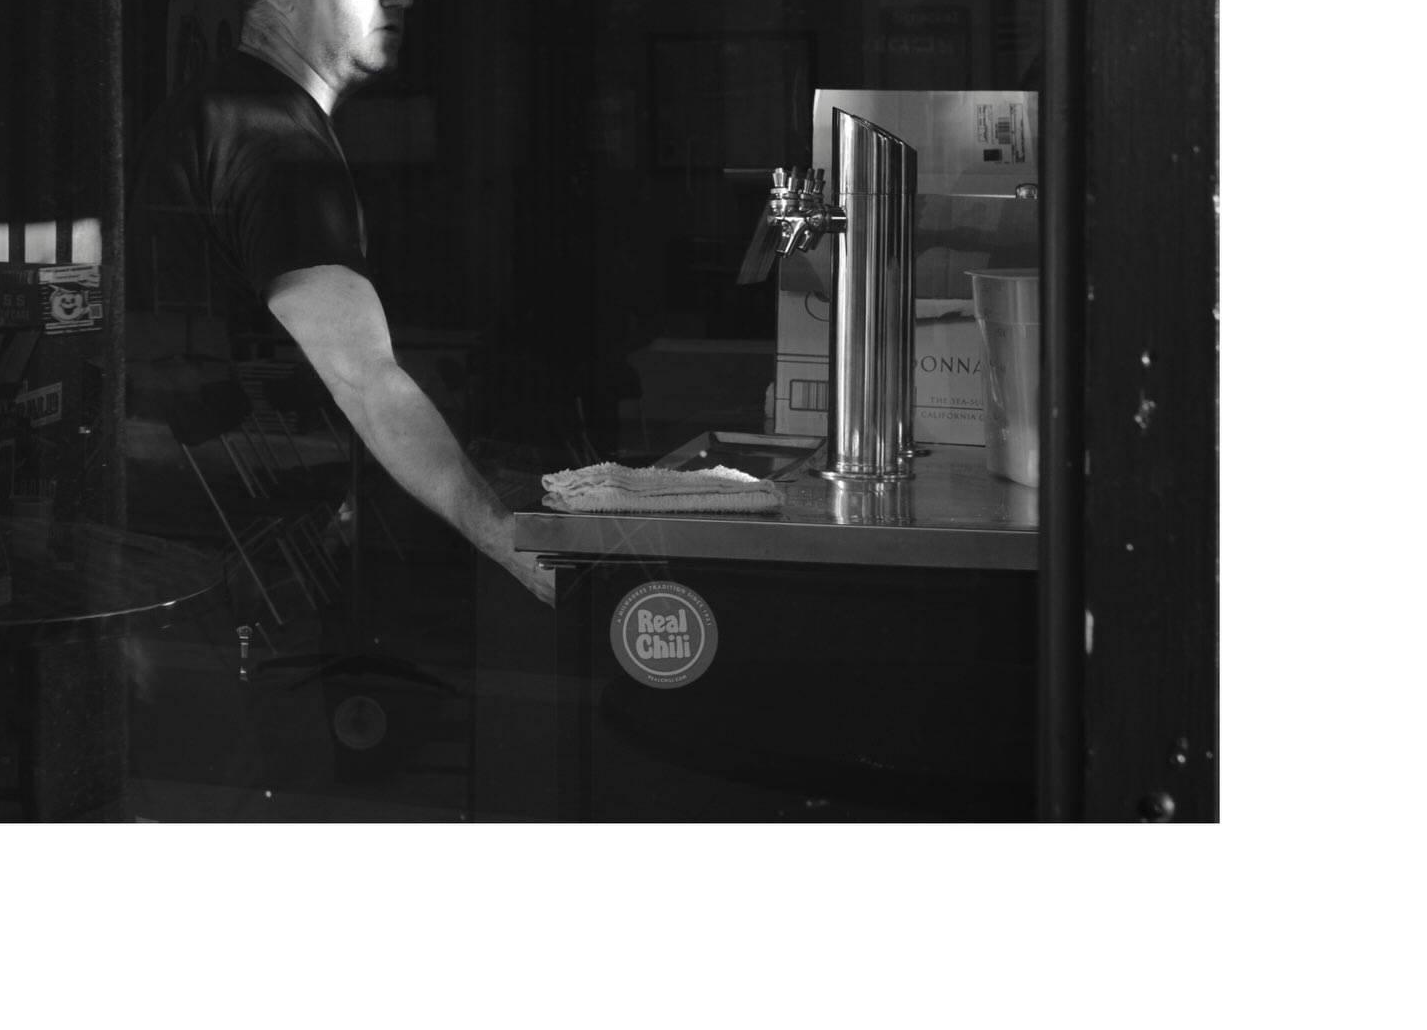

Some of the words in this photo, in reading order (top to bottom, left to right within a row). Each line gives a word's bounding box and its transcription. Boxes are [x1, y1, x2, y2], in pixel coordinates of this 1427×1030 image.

[920, 411, 976, 421] CALIFORNIA
[617, 587, 648, 617] MILWAUKEE
[648, 583, 687, 595] TRADITION
[686, 591, 704, 609] SINCE
[637, 608, 688, 634] Real
[635, 633, 691, 660] Chili
